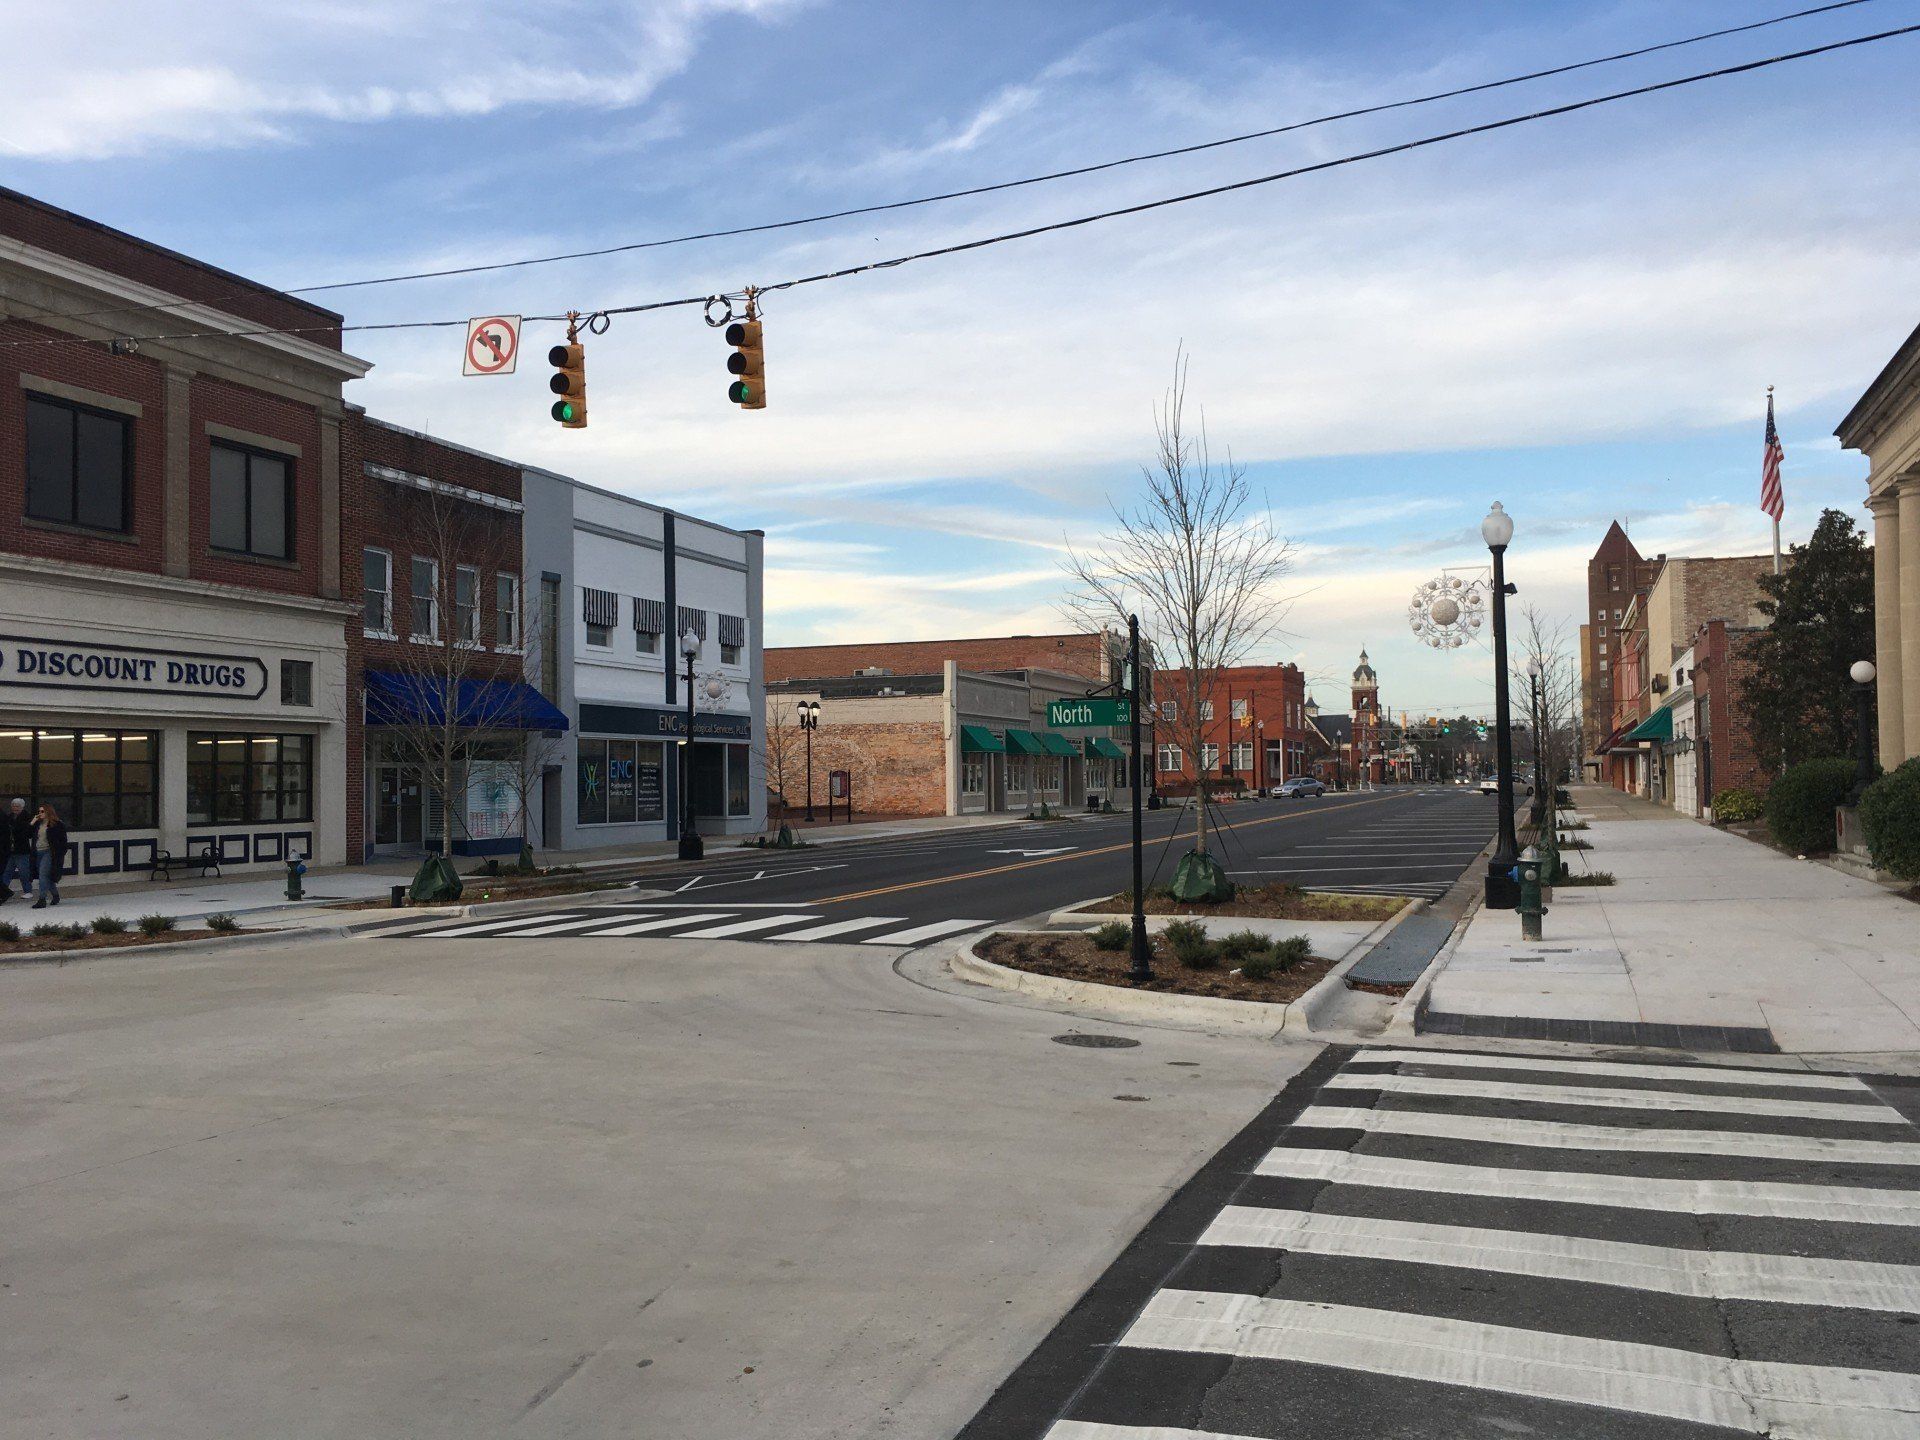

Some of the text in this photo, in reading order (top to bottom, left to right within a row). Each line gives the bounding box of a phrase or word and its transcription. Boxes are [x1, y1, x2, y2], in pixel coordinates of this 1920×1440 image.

[17, 649, 156, 681] DISCOUNT
[166, 661, 247, 688] DRUGS
[1052, 704, 1092, 724] North
[1116, 714, 1128, 722] 100
[658, 715, 678, 732] ENC
[679, 722, 713, 735] Psyological
[610, 760, 633, 779] ENC
